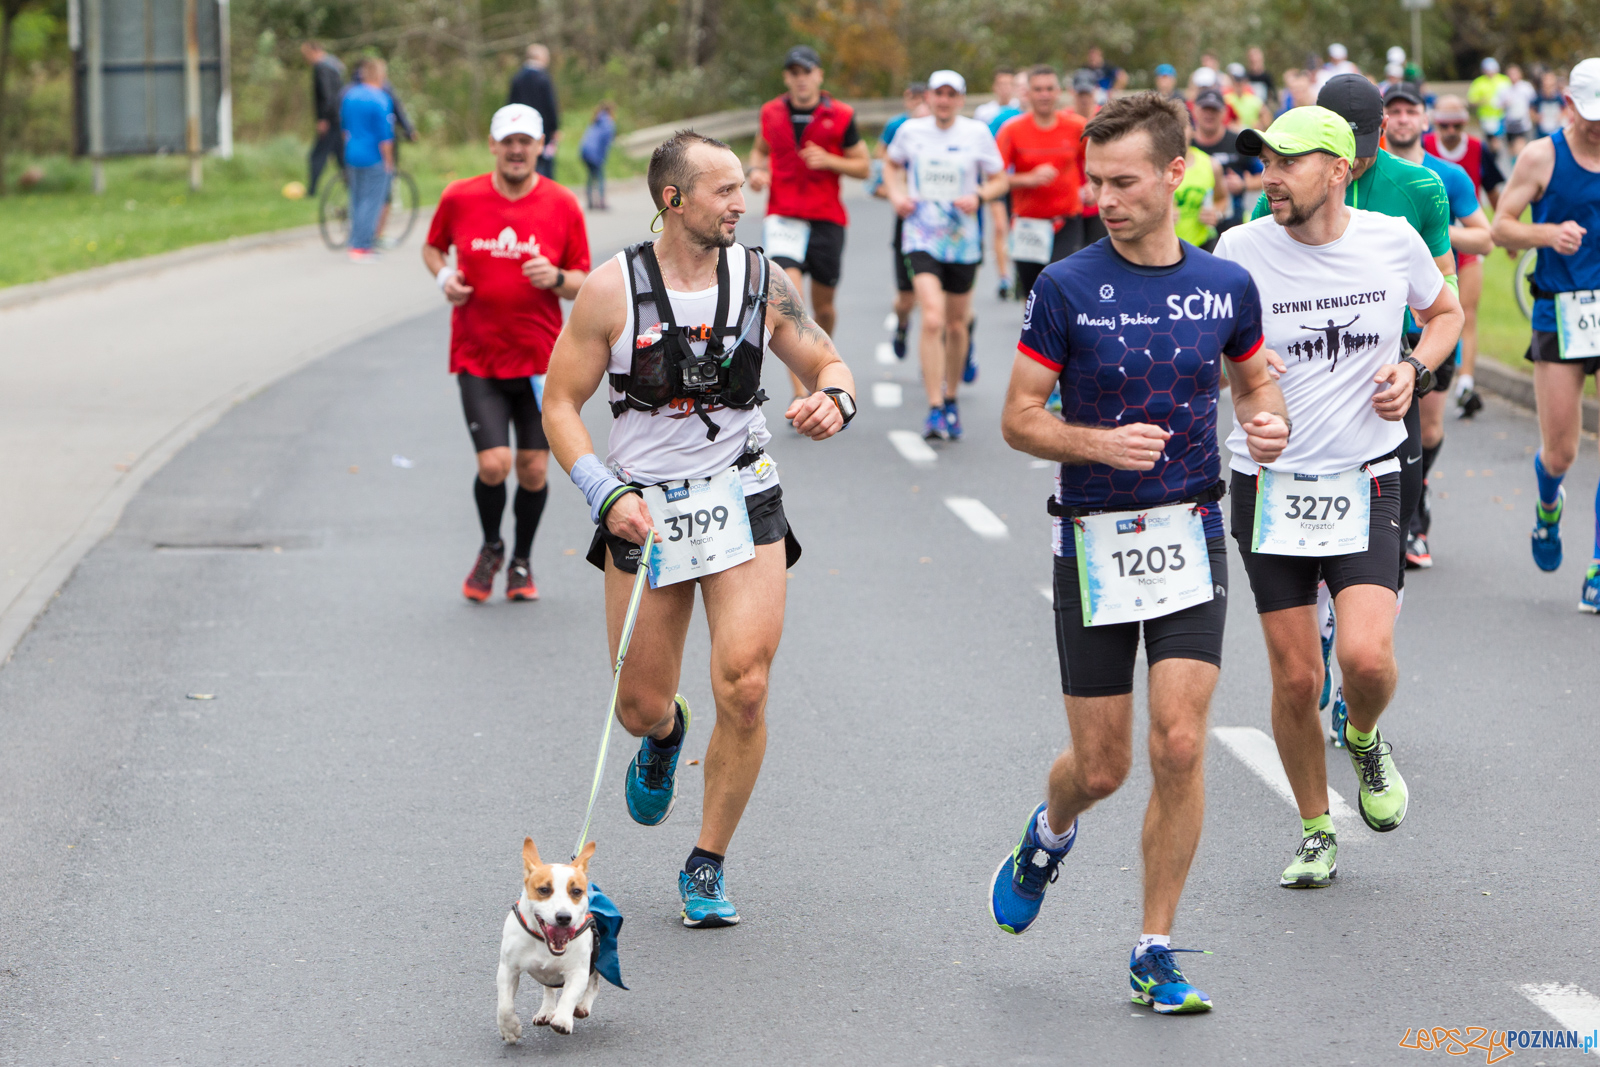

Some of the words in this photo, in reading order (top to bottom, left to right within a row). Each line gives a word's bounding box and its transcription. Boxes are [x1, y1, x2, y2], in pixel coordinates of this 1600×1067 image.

[1272, 300, 1312, 314] SŁYNNI
[1316, 290, 1386, 310] KENIJCZYCY
[1077, 312, 1116, 330] Maciej
[1120, 312, 1161, 326] Bekier
[674, 489, 687, 499] PKO
[1285, 495, 1350, 521] 3279
[664, 505, 729, 542] 3799
[1300, 521, 1336, 530] Krzysztof
[690, 536, 714, 547] Marcin
[1111, 544, 1186, 577] 1203
[1138, 576, 1167, 586] Maciej
